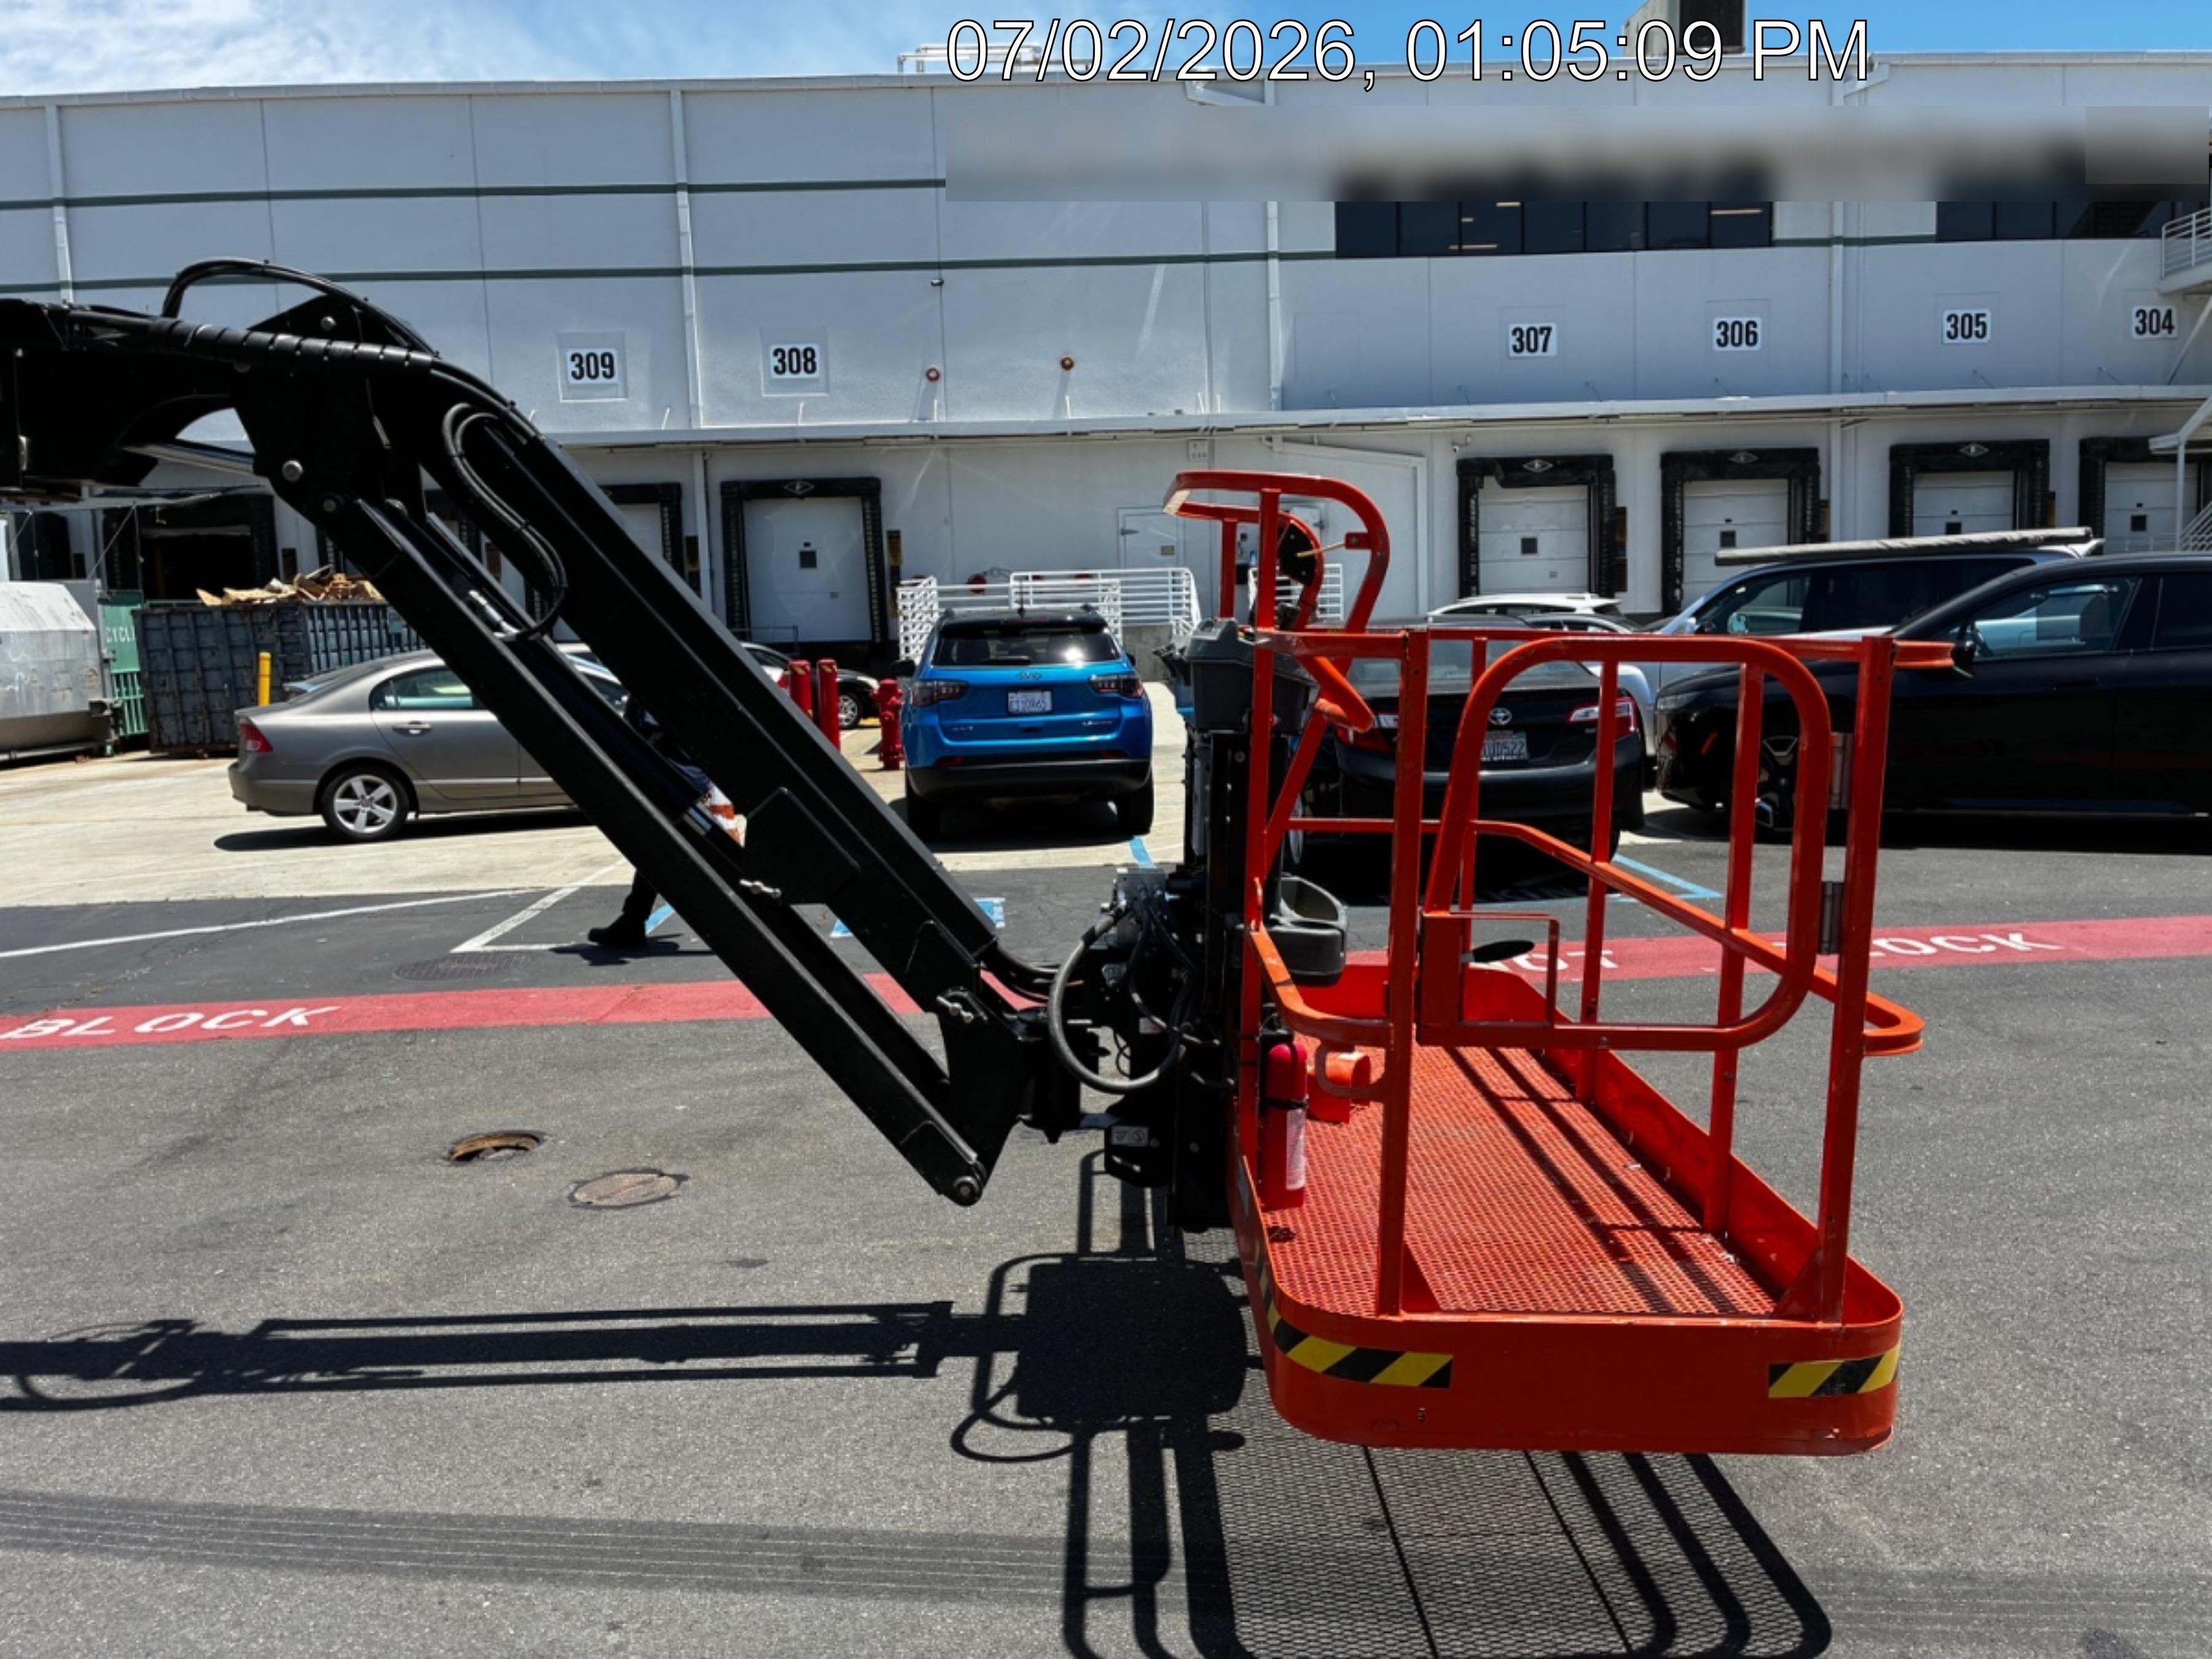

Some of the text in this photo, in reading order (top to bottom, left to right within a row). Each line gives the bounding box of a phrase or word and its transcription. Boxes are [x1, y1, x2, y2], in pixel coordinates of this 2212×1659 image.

[1716, 320, 1759, 348] 306
[1945, 312, 1988, 340] 305
[2134, 308, 2175, 335] 304
[1511, 326, 1553, 354] 307
[570, 351, 616, 380] 309
[772, 346, 818, 375] 308
[0, 1006, 342, 1040] BLOCK
